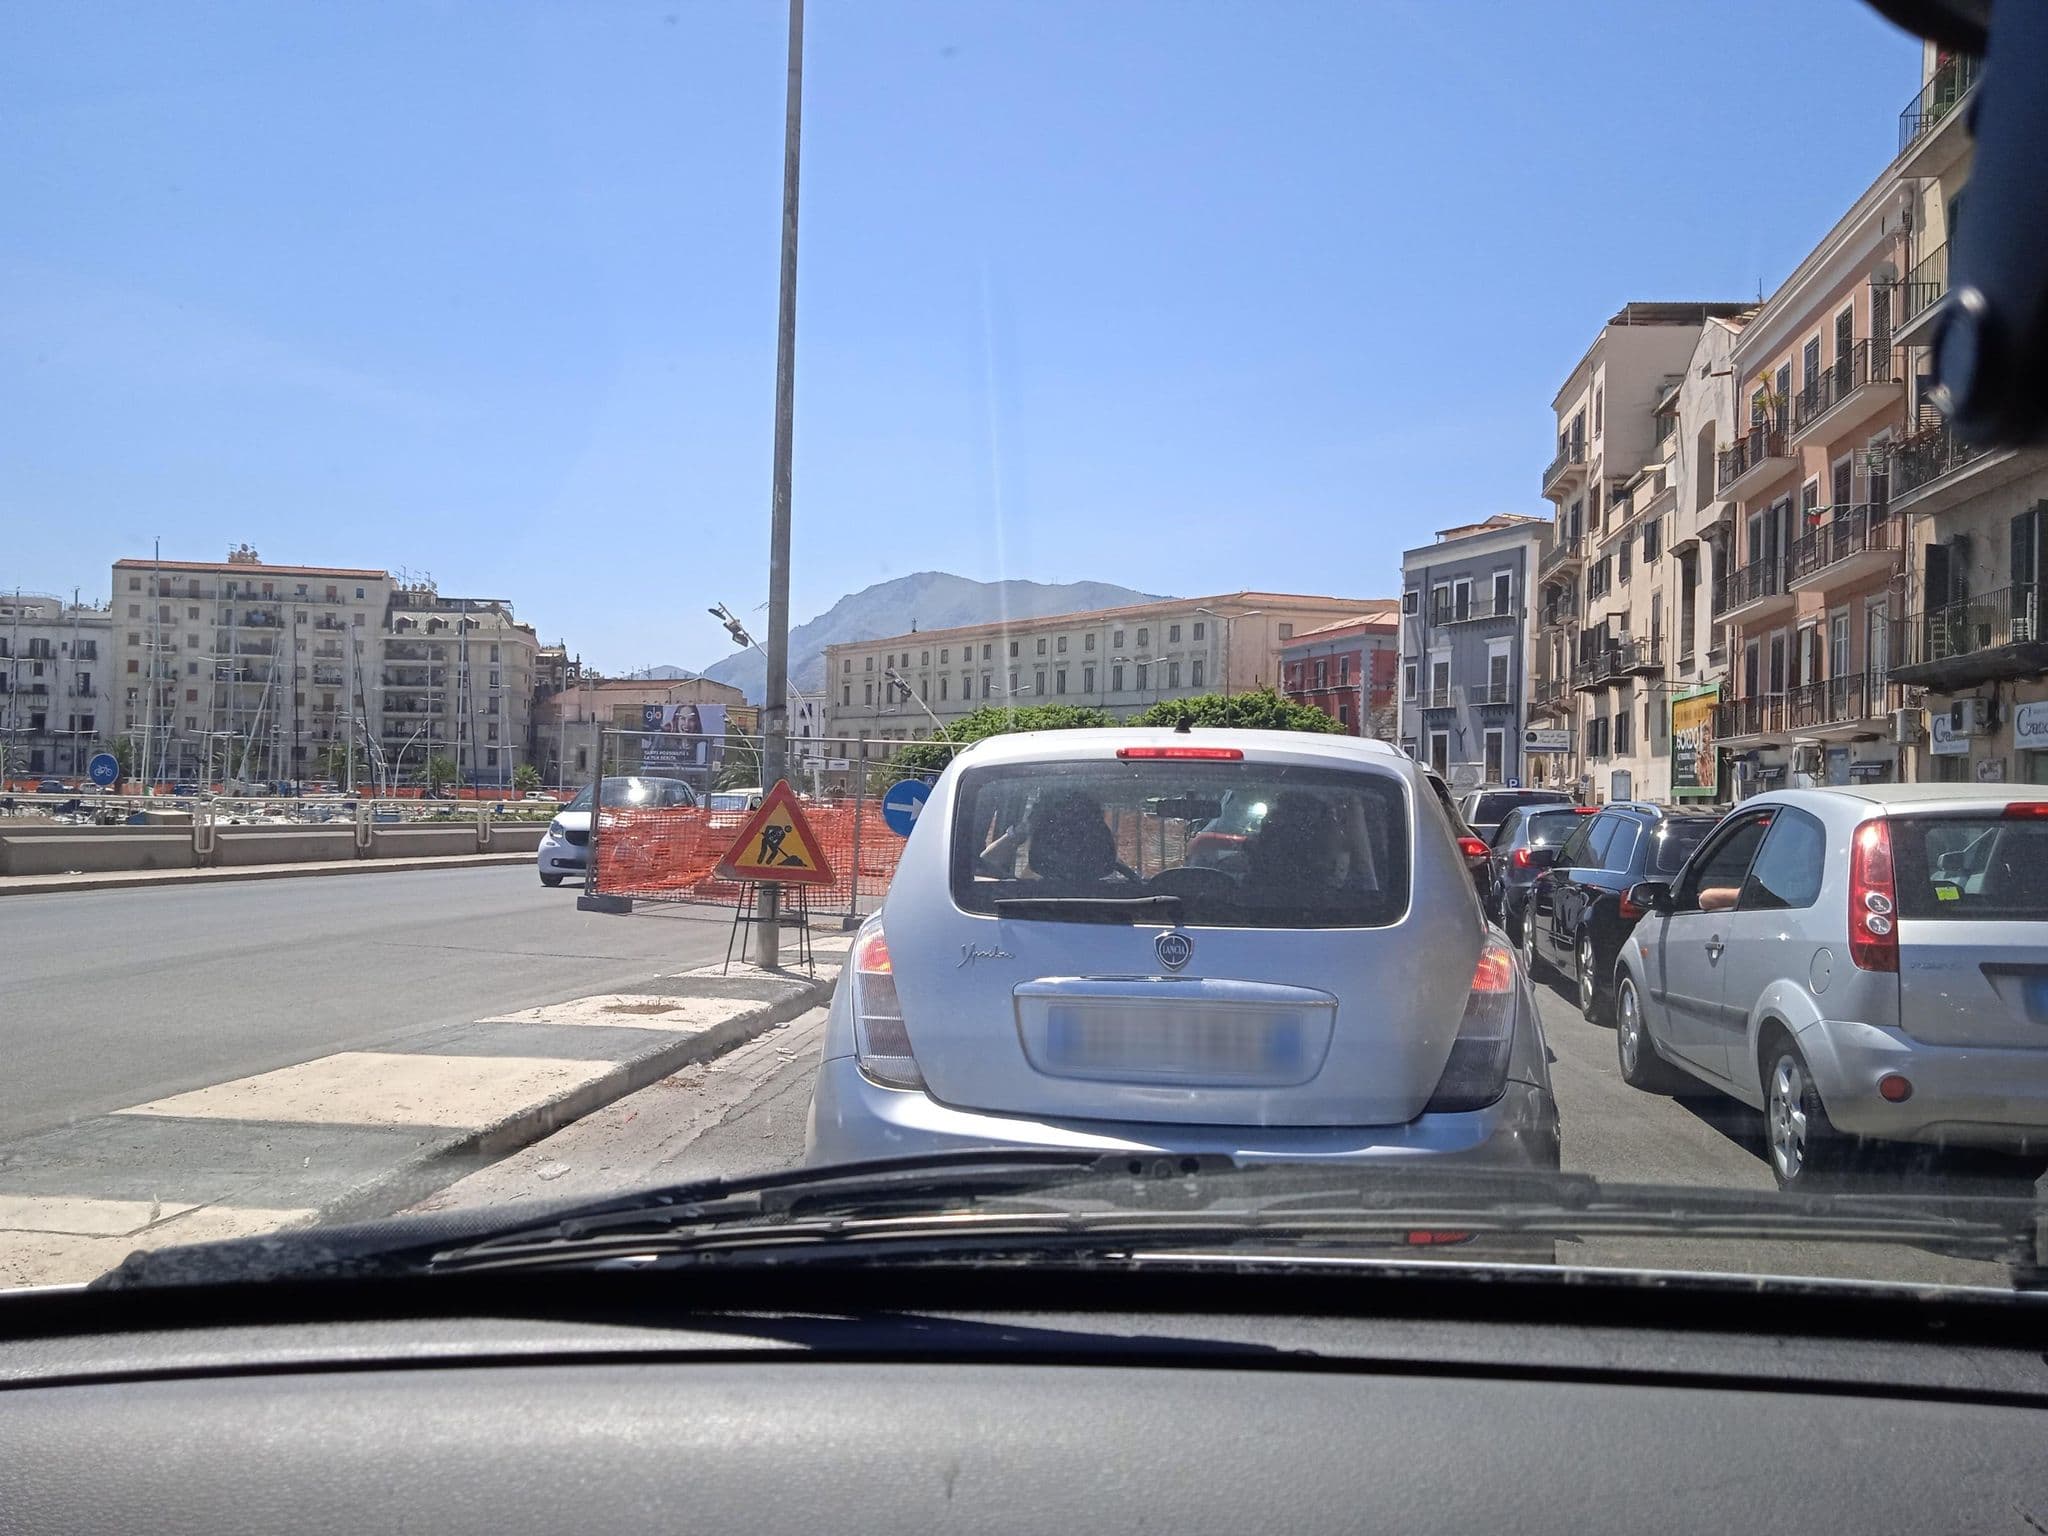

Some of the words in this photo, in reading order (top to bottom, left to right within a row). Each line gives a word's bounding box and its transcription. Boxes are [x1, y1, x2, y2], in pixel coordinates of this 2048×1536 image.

[646, 706, 662, 722] glo
[1509, 779, 1518, 788] P
[1162, 945, 1185, 955] LANCIA
